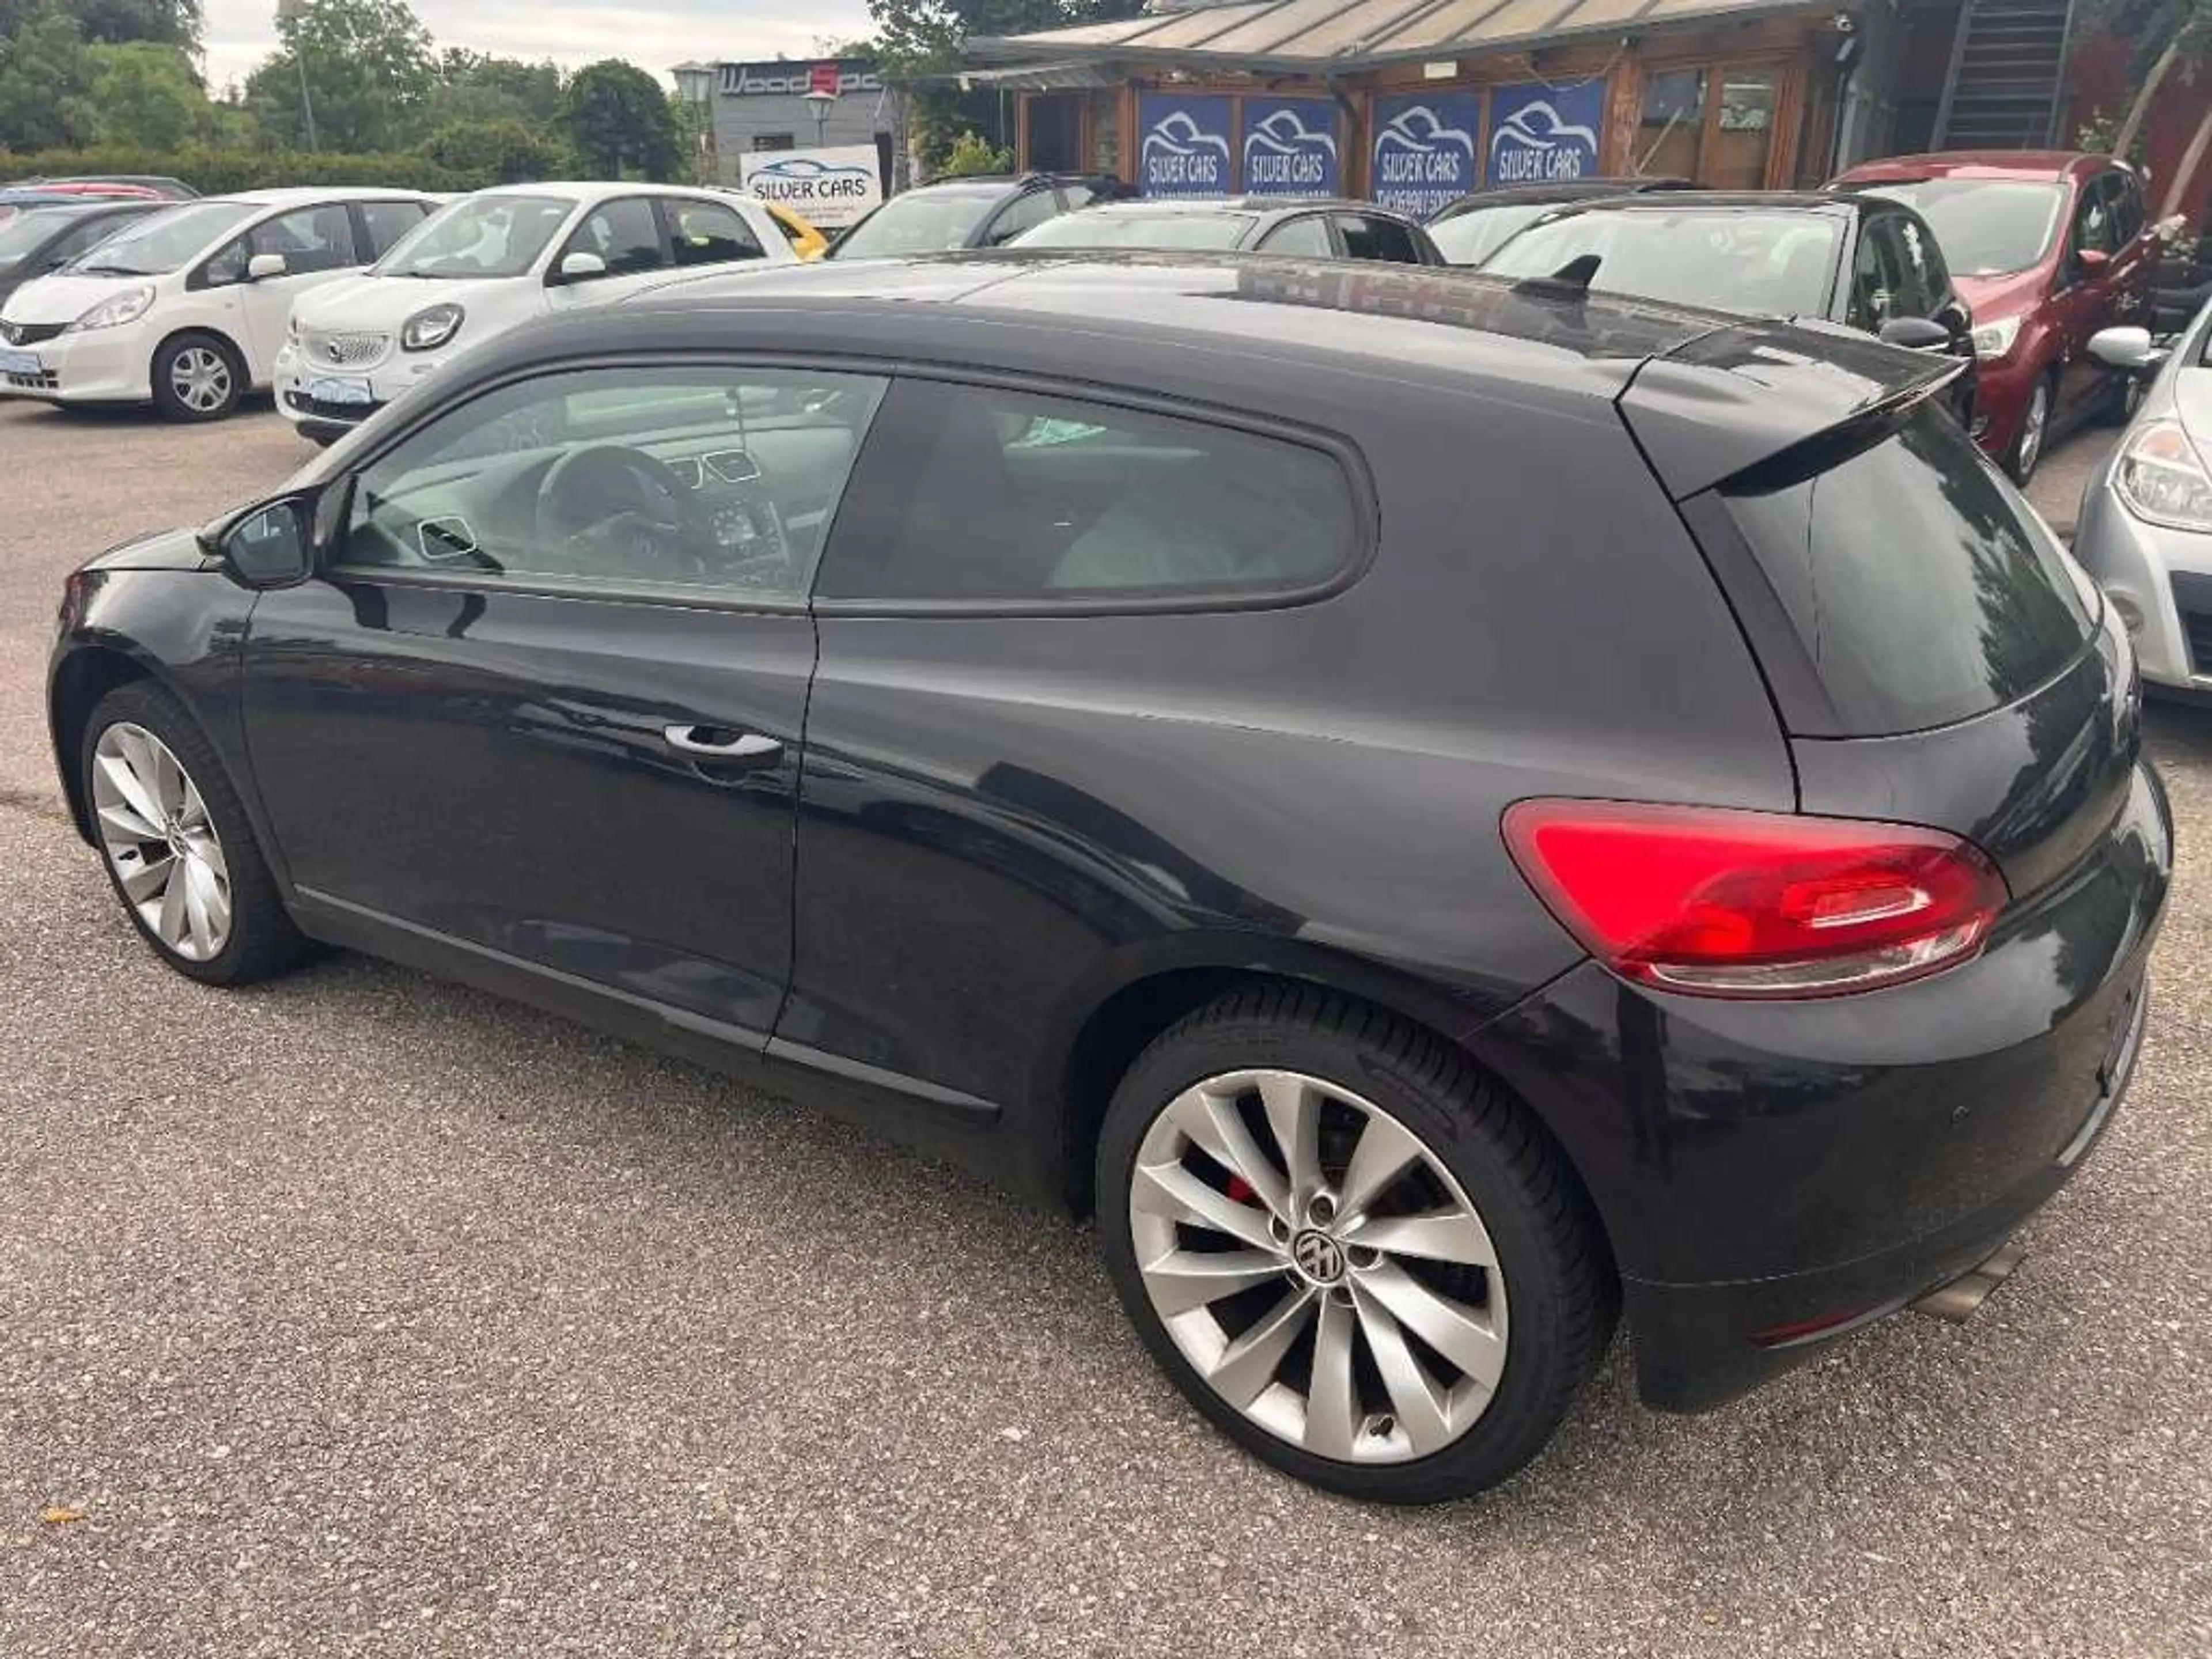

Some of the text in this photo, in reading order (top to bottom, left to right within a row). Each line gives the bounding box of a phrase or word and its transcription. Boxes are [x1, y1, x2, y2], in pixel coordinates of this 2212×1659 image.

[1292, 154, 1323, 183] CARS
[1425, 151, 1460, 181] CARS
[1546, 148, 1581, 179] CARS
[754, 178, 866, 200] SILVER CARS
